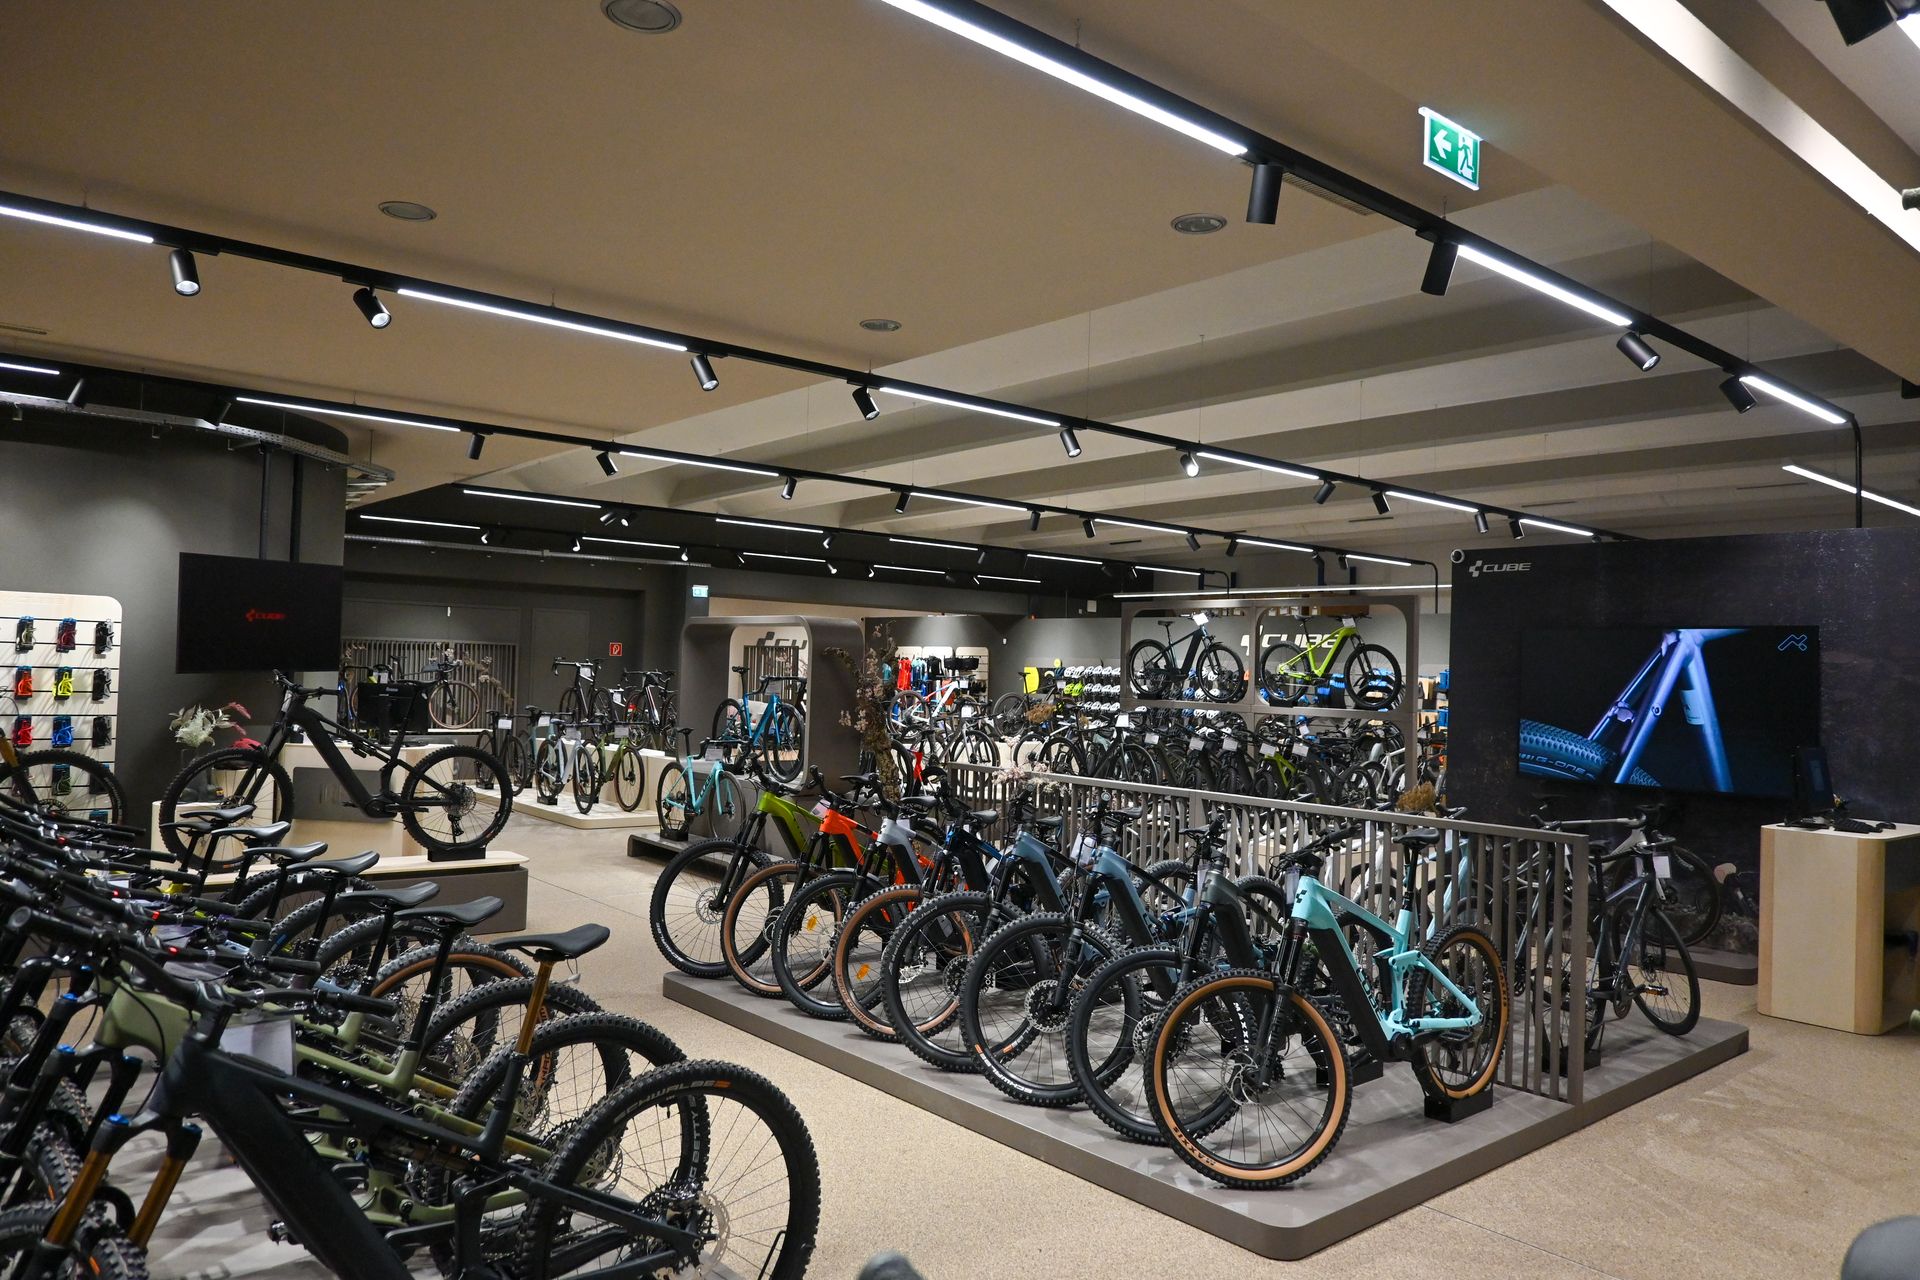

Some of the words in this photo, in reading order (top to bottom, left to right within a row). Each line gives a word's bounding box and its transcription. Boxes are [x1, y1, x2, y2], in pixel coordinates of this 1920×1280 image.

[1482, 562, 1532, 573] CUBE
[979, 1052, 1033, 1094] SCHWALBE
[613, 1079, 716, 1123] SCHWALBE
[691, 1110, 701, 1163] BETTY
[1172, 1126, 1216, 1166] MAXXIS
